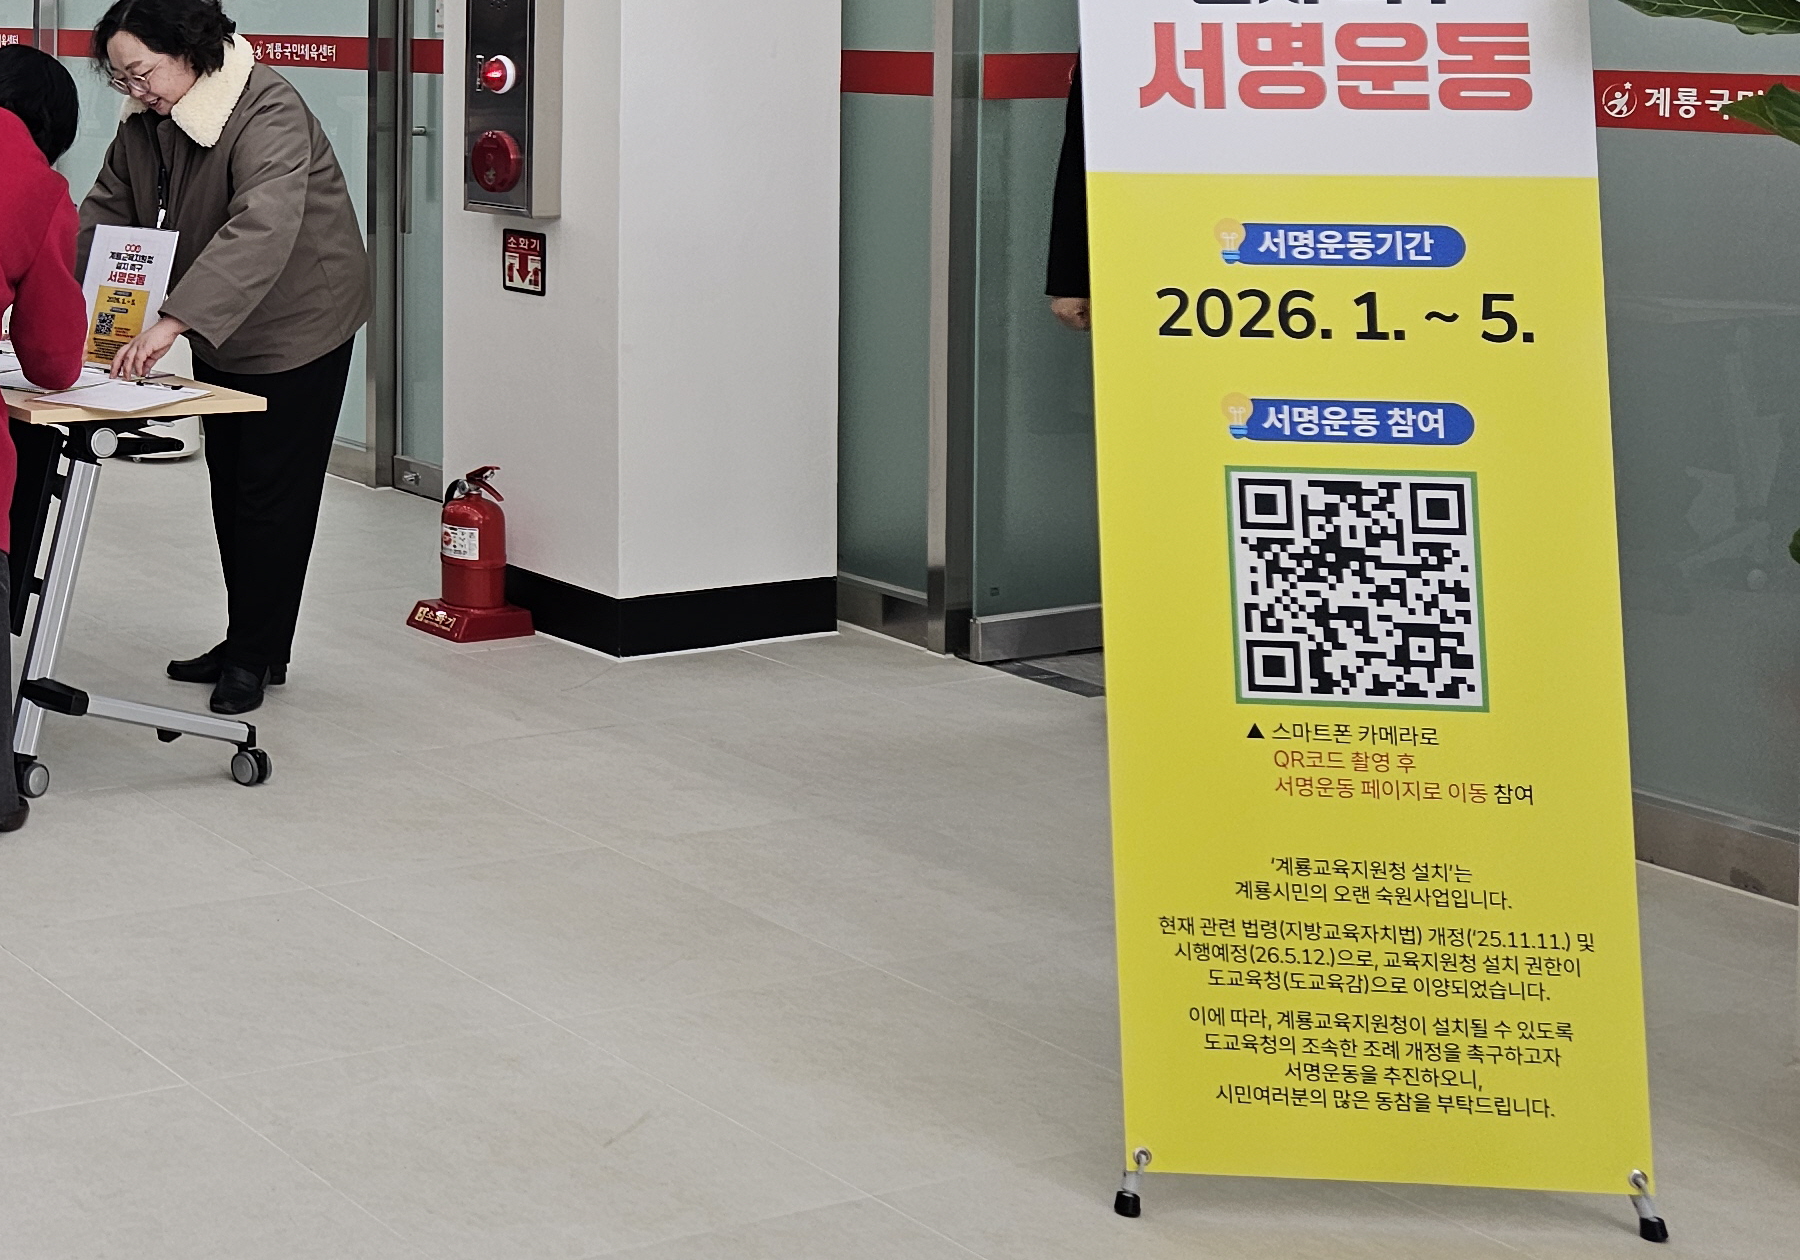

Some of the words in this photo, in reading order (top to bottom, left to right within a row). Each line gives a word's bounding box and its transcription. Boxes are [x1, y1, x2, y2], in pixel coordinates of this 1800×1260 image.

[266, 42, 336, 62] 계룡국민체육센터
[1139, 21, 1534, 111] 서명운동
[1644, 87, 1764, 120] 계룡국
[507, 236, 540, 252] 소화기
[1258, 231, 1434, 261] 서명운동기간
[1156, 287, 1333, 339] 2026.
[1353, 291, 1405, 340] 1.
[1481, 292, 1535, 344] 5.
[1262, 405, 1380, 437] 서명운동
[1388, 407, 1446, 438] 참여
[1272, 722, 1352, 744] 스마트폰
[1358, 725, 1439, 746] 카메라로
[1274, 750, 1345, 769] QR코드
[1351, 751, 1389, 772] 촬영
[1397, 753, 1416, 773] 후
[1275, 776, 1355, 798] 서명운동
[1361, 779, 1442, 801] 페이지로
[1449, 783, 1488, 803] 이동
[1494, 784, 1533, 805] 참여
[1235, 880, 1327, 903] 계룡시민의
[1333, 886, 1370, 904] 오랜
[1375, 886, 1512, 910] 숙원사업입니다.
[1159, 916, 1194, 936] 현재
[1200, 917, 1236, 937] 관련
[1242, 919, 1422, 946] 법령(지방교육자치법)
[1577, 933, 1594, 952] 및
[1174, 942, 1378, 971] 시행예정(26.5.12.)으로,
[1383, 952, 1476, 973] 교육지원청
[1483, 955, 1519, 975] 설치
[1524, 956, 1580, 978] 권한이
[1208, 969, 1408, 994] 도교육청(도교육감)으로
[1414, 977, 1550, 1001] 이양되었습니다.
[1189, 1006, 1225, 1026] 이에
[1230, 1008, 1272, 1031] 따라,
[1277, 1010, 1426, 1036] 계룡교육지원청이
[1432, 1017, 1488, 1038] 설치될
[1494, 1020, 1512, 1039] 수
[1517, 1021, 1573, 1042] 있도록
[1204, 1033, 1295, 1055] 도교육청의
[1302, 1038, 1358, 1058] 조속한
[1363, 1041, 1399, 1060] 조례
[1405, 1042, 1461, 1063] 개정을
[1466, 1044, 1562, 1067] 촉구하고자
[1285, 1062, 1378, 1085] 서명운동을
[1383, 1066, 1482, 1092] 추진하오니,
[1216, 1084, 1326, 1108] 시민여러분의
[1333, 1090, 1370, 1110] 많은
[1375, 1092, 1431, 1113] 동참을
[1436, 1095, 1555, 1118] 부탁드립니다.
